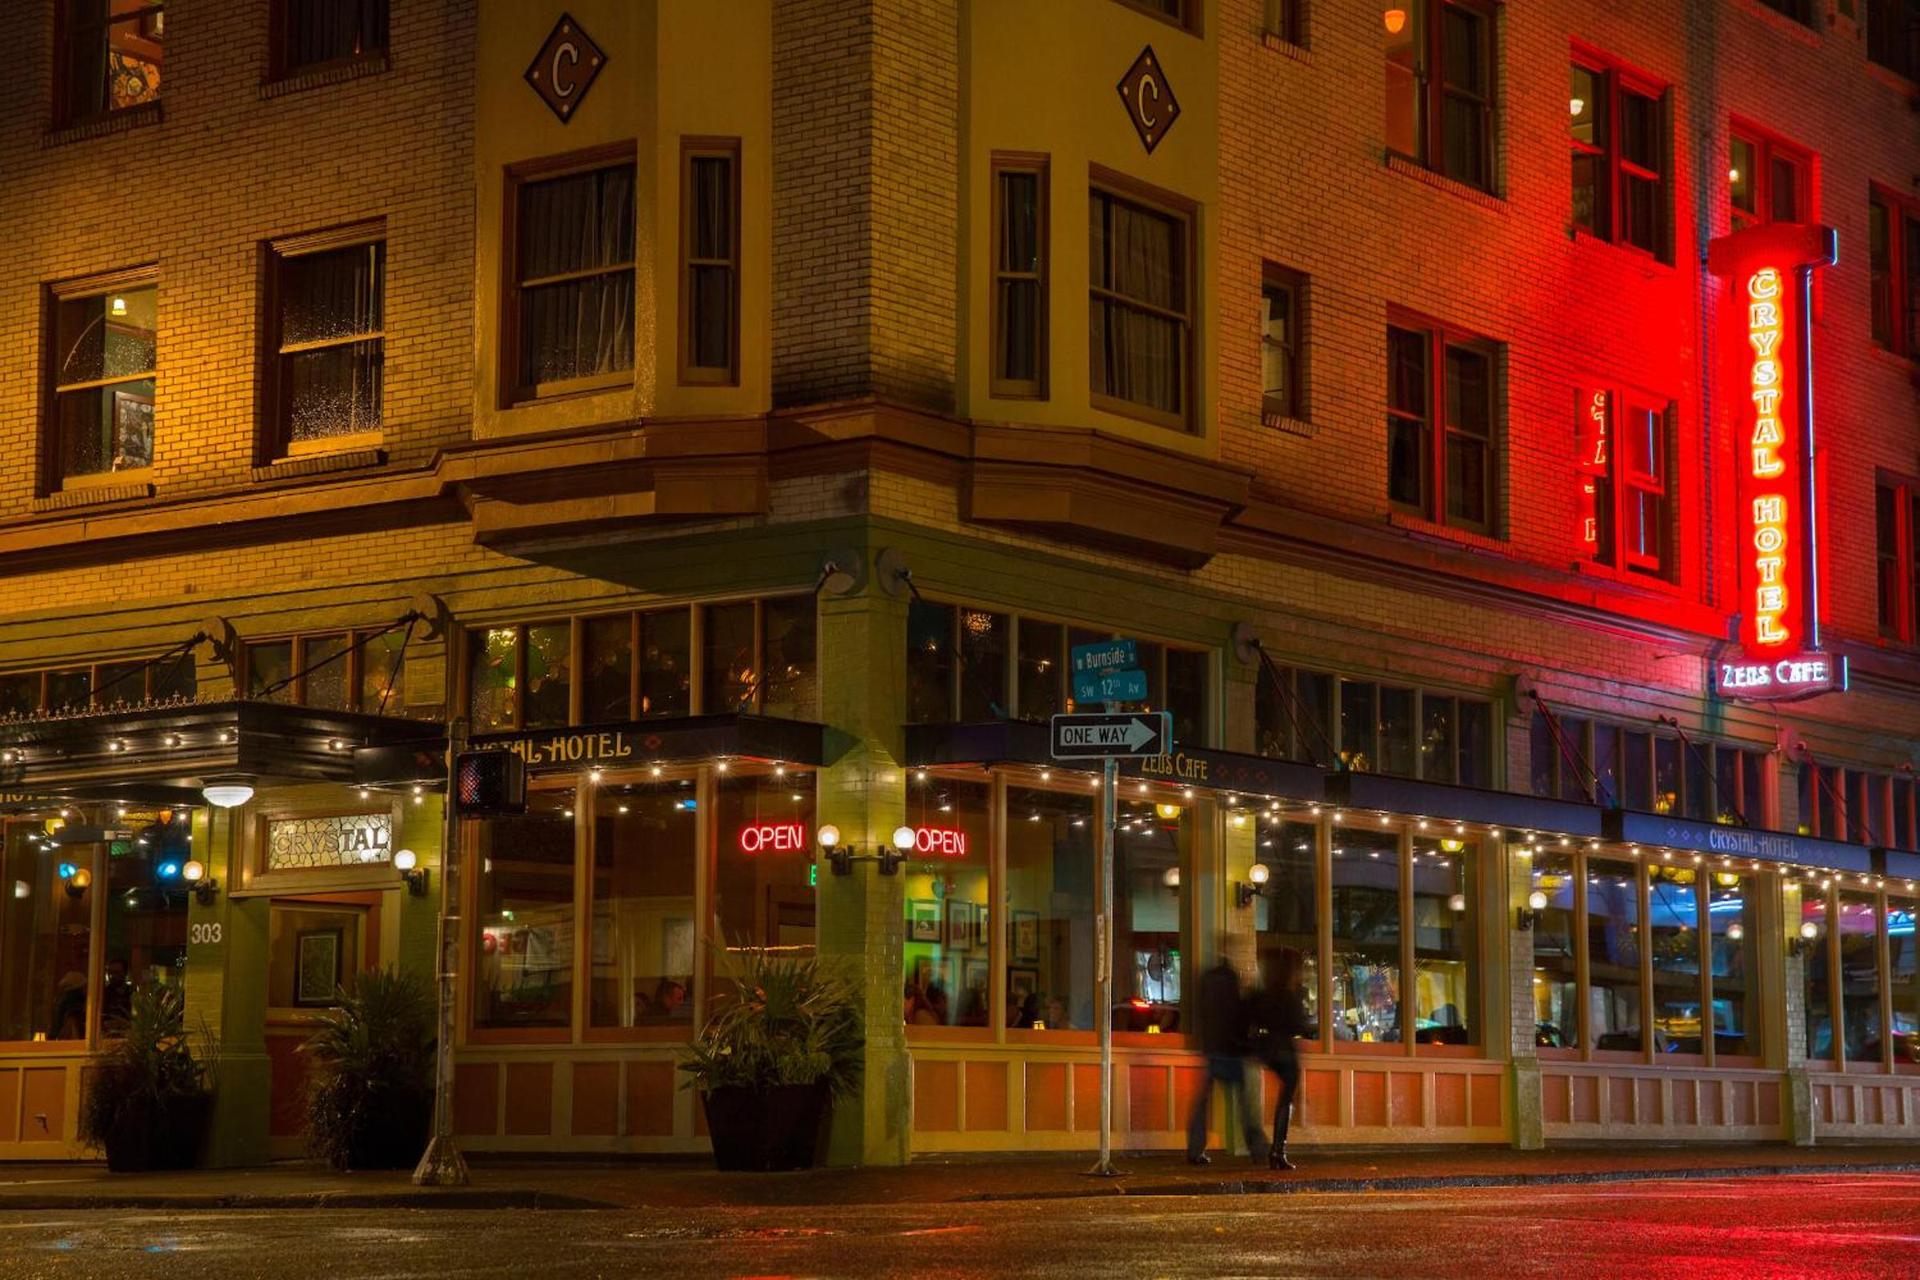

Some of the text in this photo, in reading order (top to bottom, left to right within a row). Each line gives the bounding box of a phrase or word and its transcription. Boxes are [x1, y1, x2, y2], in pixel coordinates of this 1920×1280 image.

[553, 42, 577, 97] C
[1138, 74, 1158, 127] C
[1748, 268, 1787, 645] CRYSTAL HOTEL
[1086, 647, 1125, 669] Burnside
[1081, 686, 1094, 697] SW
[550, 732, 632, 763] HOTEL
[1064, 727, 1128, 744] ONE WAY
[1175, 753, 1208, 780] CAFE
[275, 828, 388, 855] CRYSTAL
[741, 826, 803, 851] OPEN
[915, 828, 965, 855] OPEN
[1710, 829, 1798, 859] CRYSTAL HOTEL
[191, 922, 222, 944] 303
